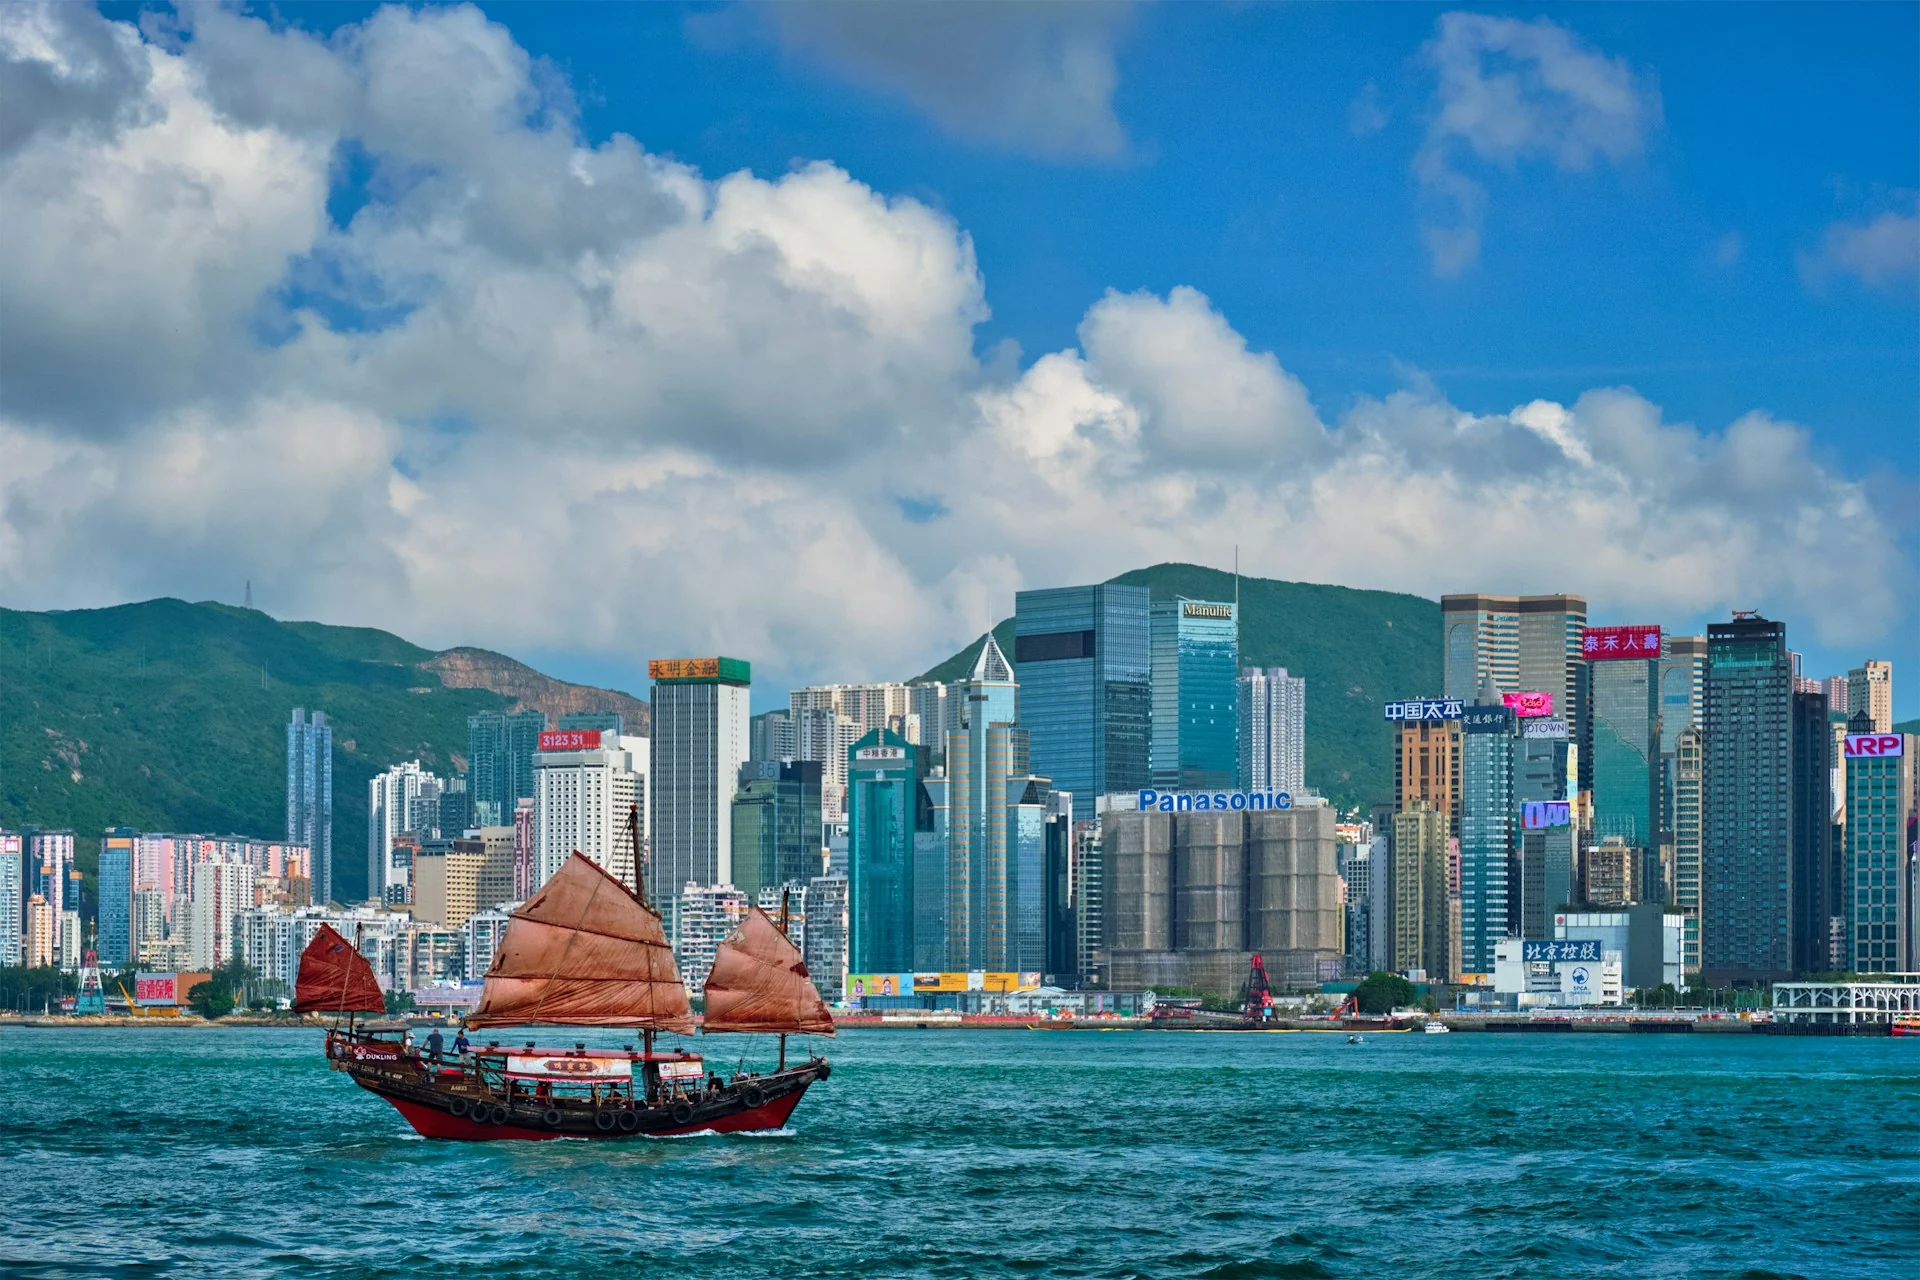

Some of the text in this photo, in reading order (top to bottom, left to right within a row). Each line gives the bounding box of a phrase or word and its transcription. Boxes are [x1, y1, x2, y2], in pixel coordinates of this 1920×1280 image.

[1184, 603, 1232, 617] Manulife
[1584, 633, 1658, 652] 泰禾人壽
[649, 660, 718, 677] 永明金融
[1385, 701, 1462, 720] 中国太平
[1463, 714, 1503, 724] 交通銀行
[543, 734, 583, 746] 3123 31
[1845, 736, 1900, 755] ARP
[1138, 785, 1292, 812] Panasonic
[1526, 942, 1598, 960] 北京控股
